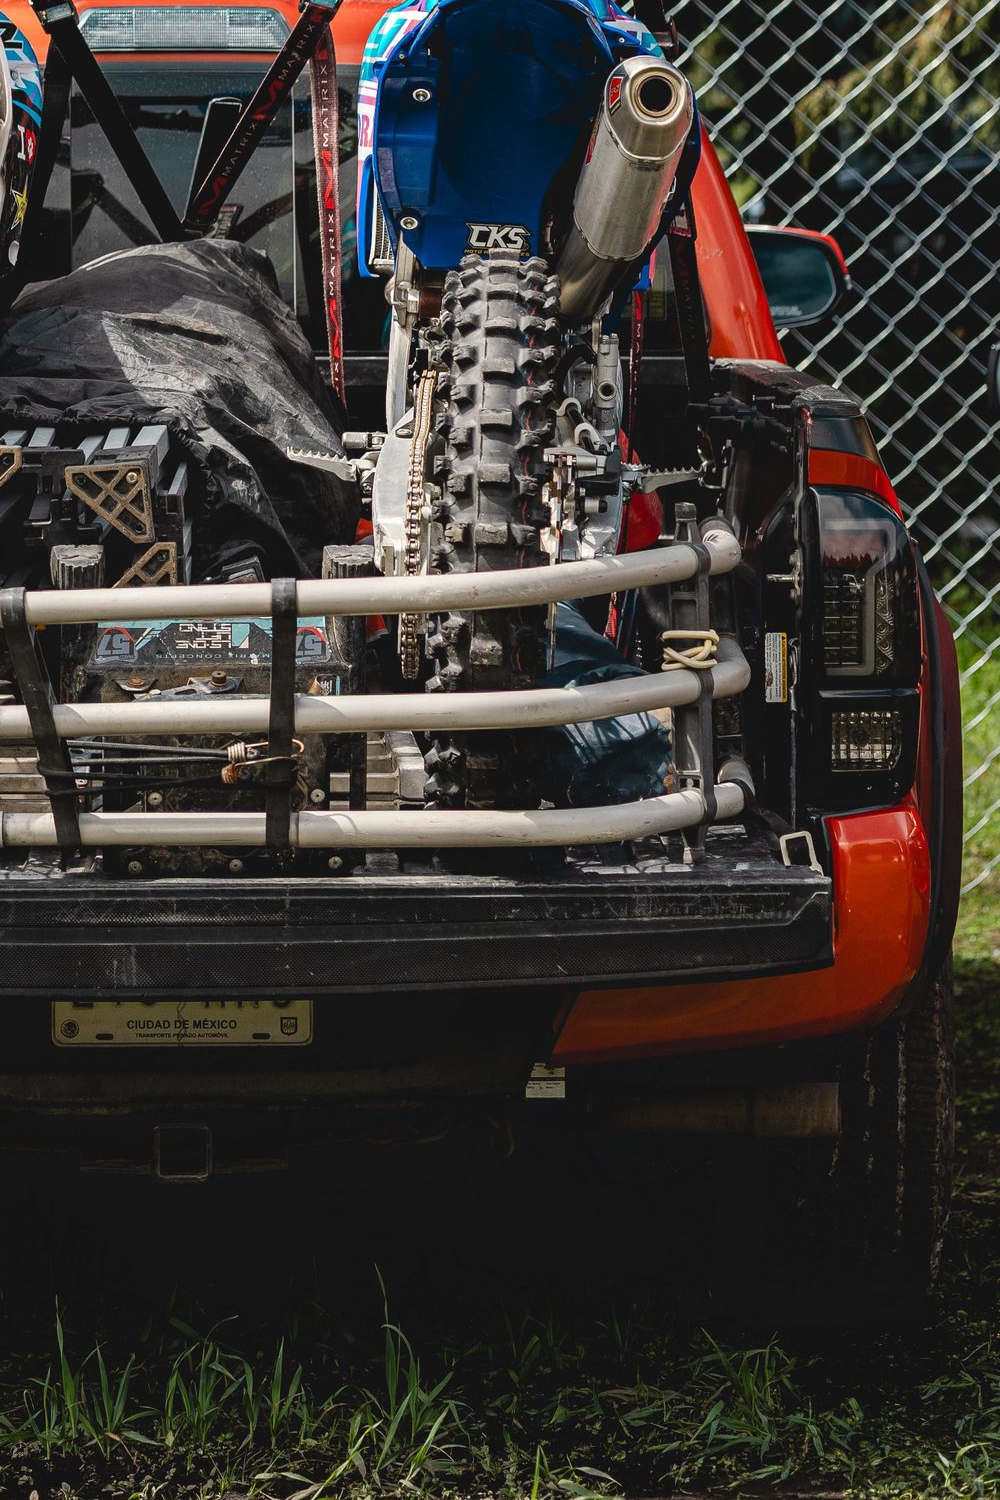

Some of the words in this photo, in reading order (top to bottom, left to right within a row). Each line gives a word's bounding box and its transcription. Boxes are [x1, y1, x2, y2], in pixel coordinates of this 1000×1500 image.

[320, 64, 330, 148] MATRIX
[221, 121, 259, 178] MATRIX
[470, 224, 527, 249] CKS
[327, 213, 336, 296] MATRIX
[97, 634, 130, 655] 57
[155, 652, 222, 660] CONCEPTS
[126, 1019, 171, 1030] CIUDAD
[174, 1019, 190, 1030] DE
[193, 1017, 238, 1030] MÉXICO
